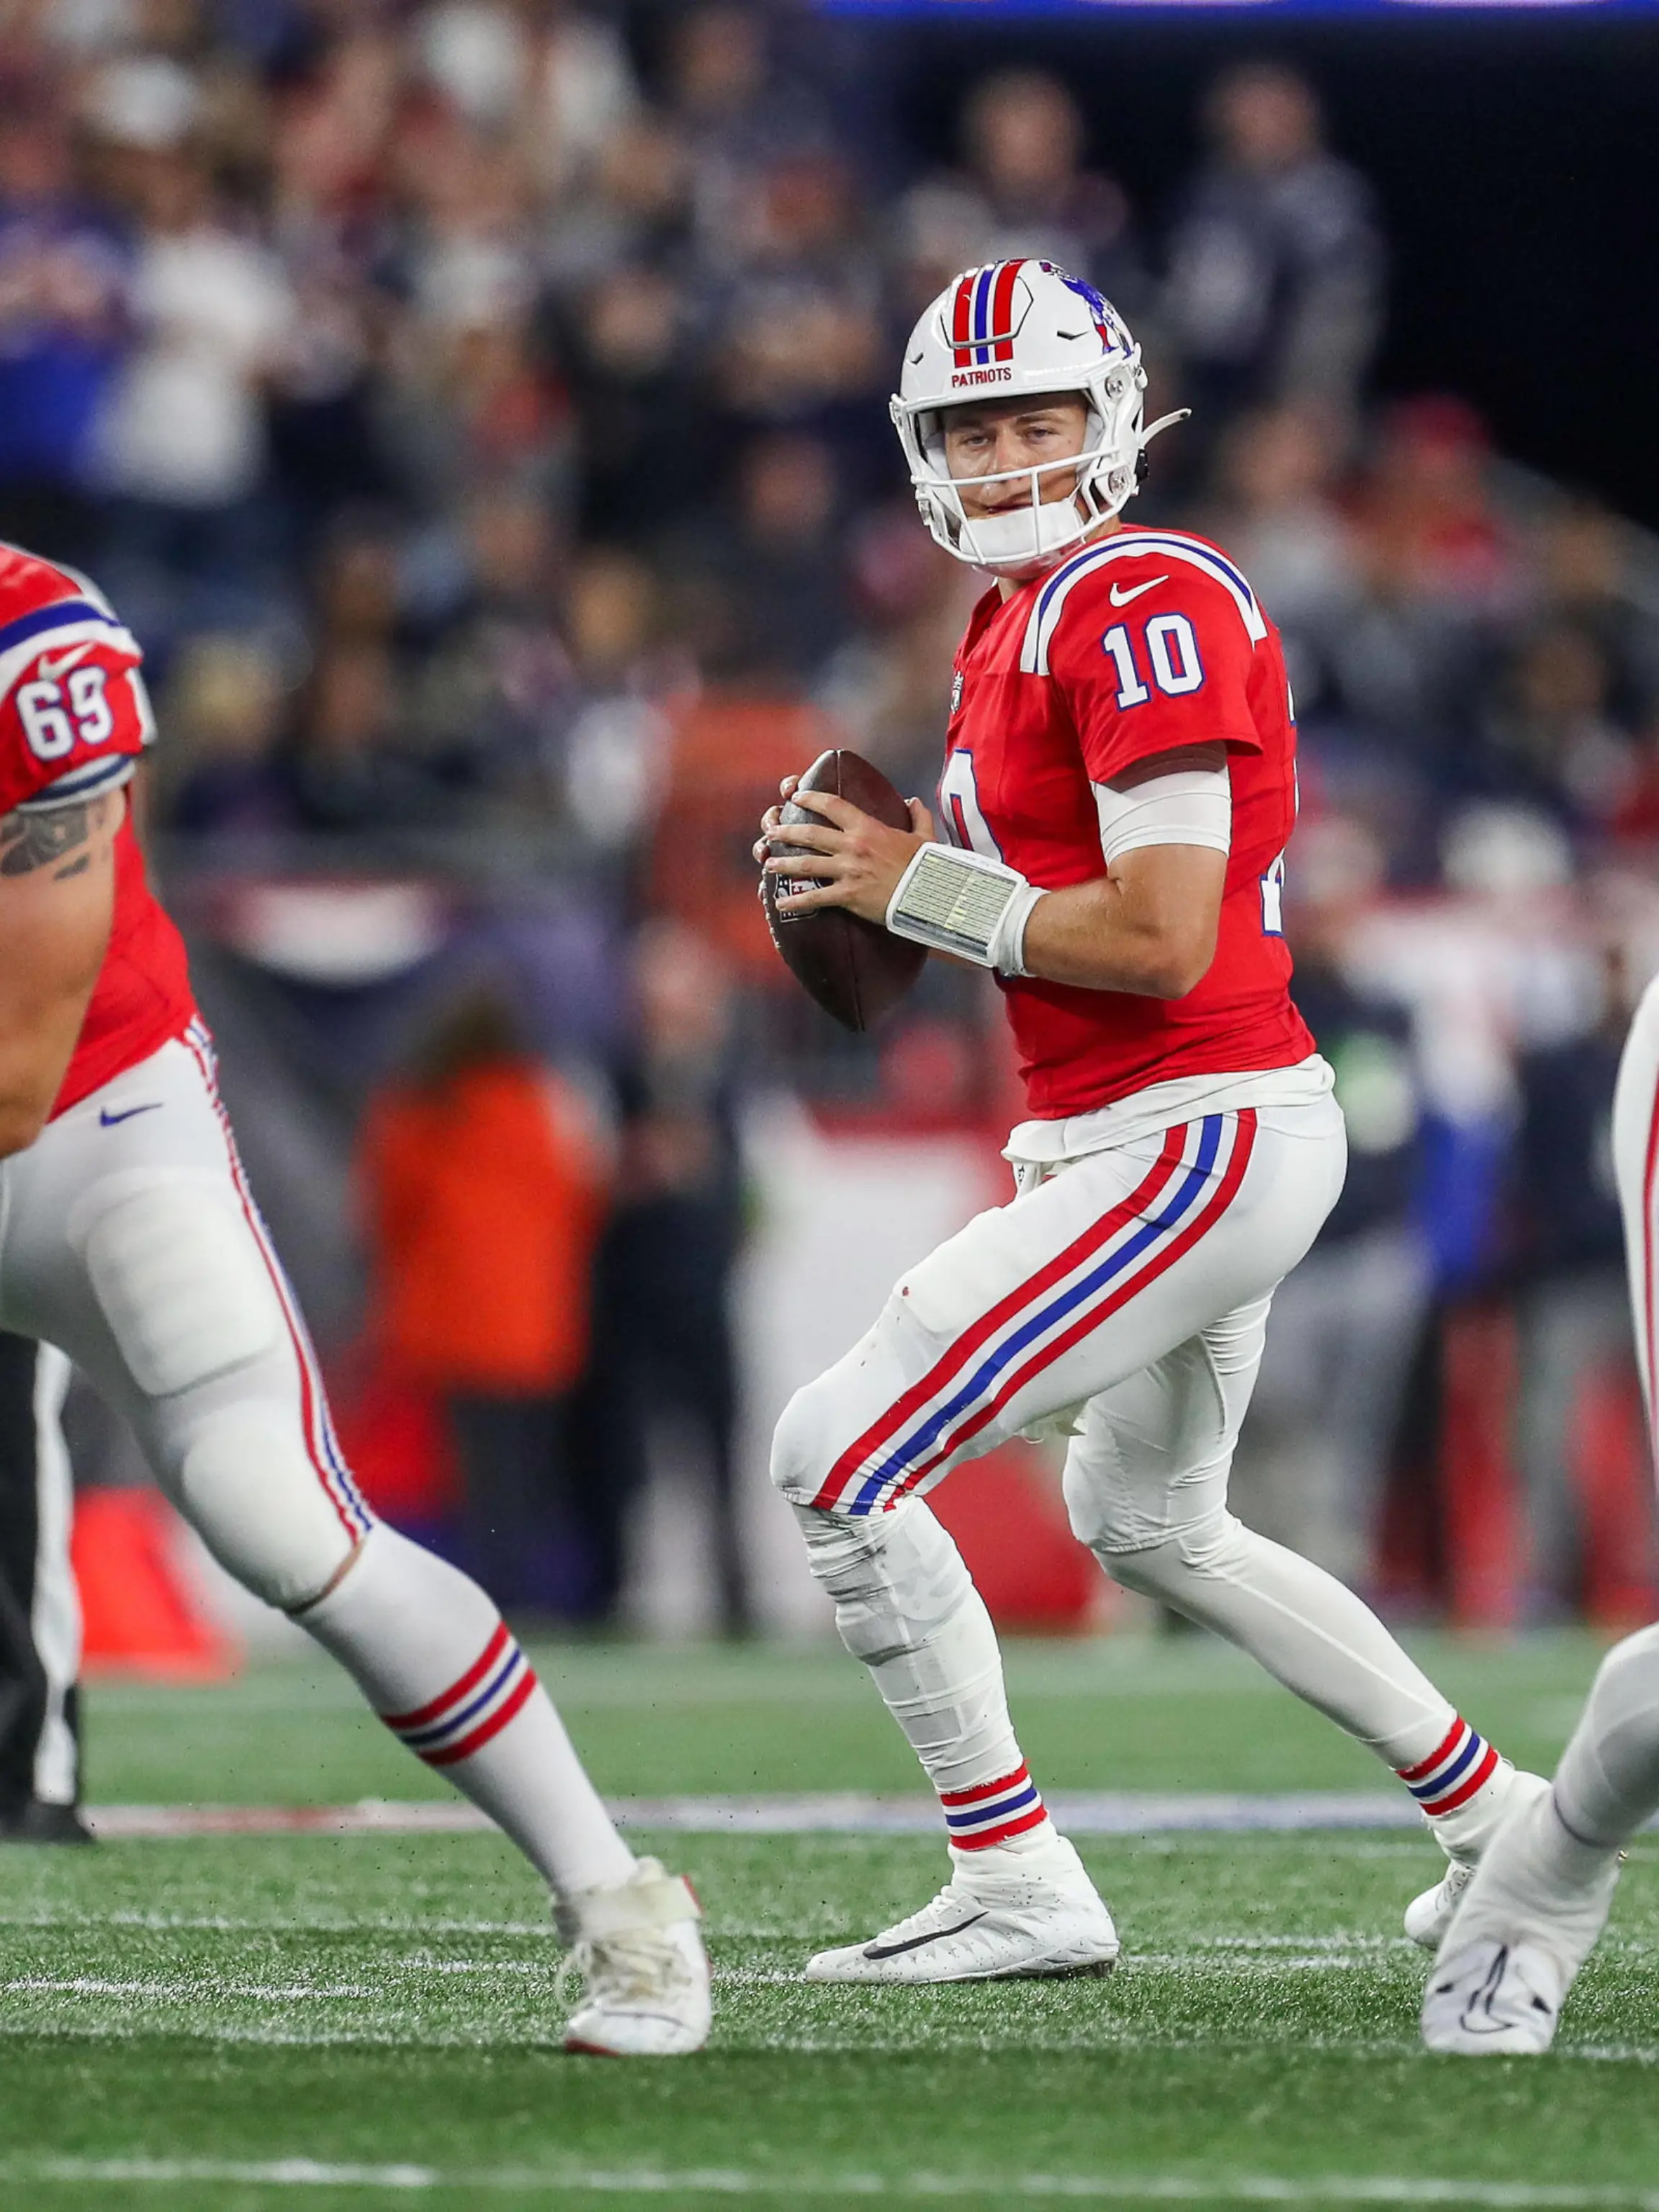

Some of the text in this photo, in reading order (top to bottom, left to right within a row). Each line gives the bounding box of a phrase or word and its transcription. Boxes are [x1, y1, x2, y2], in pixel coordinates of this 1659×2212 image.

[951, 367, 1012, 388] PATRIOTS
[1101, 611, 1206, 713] 10
[16, 665, 114, 762] 69
